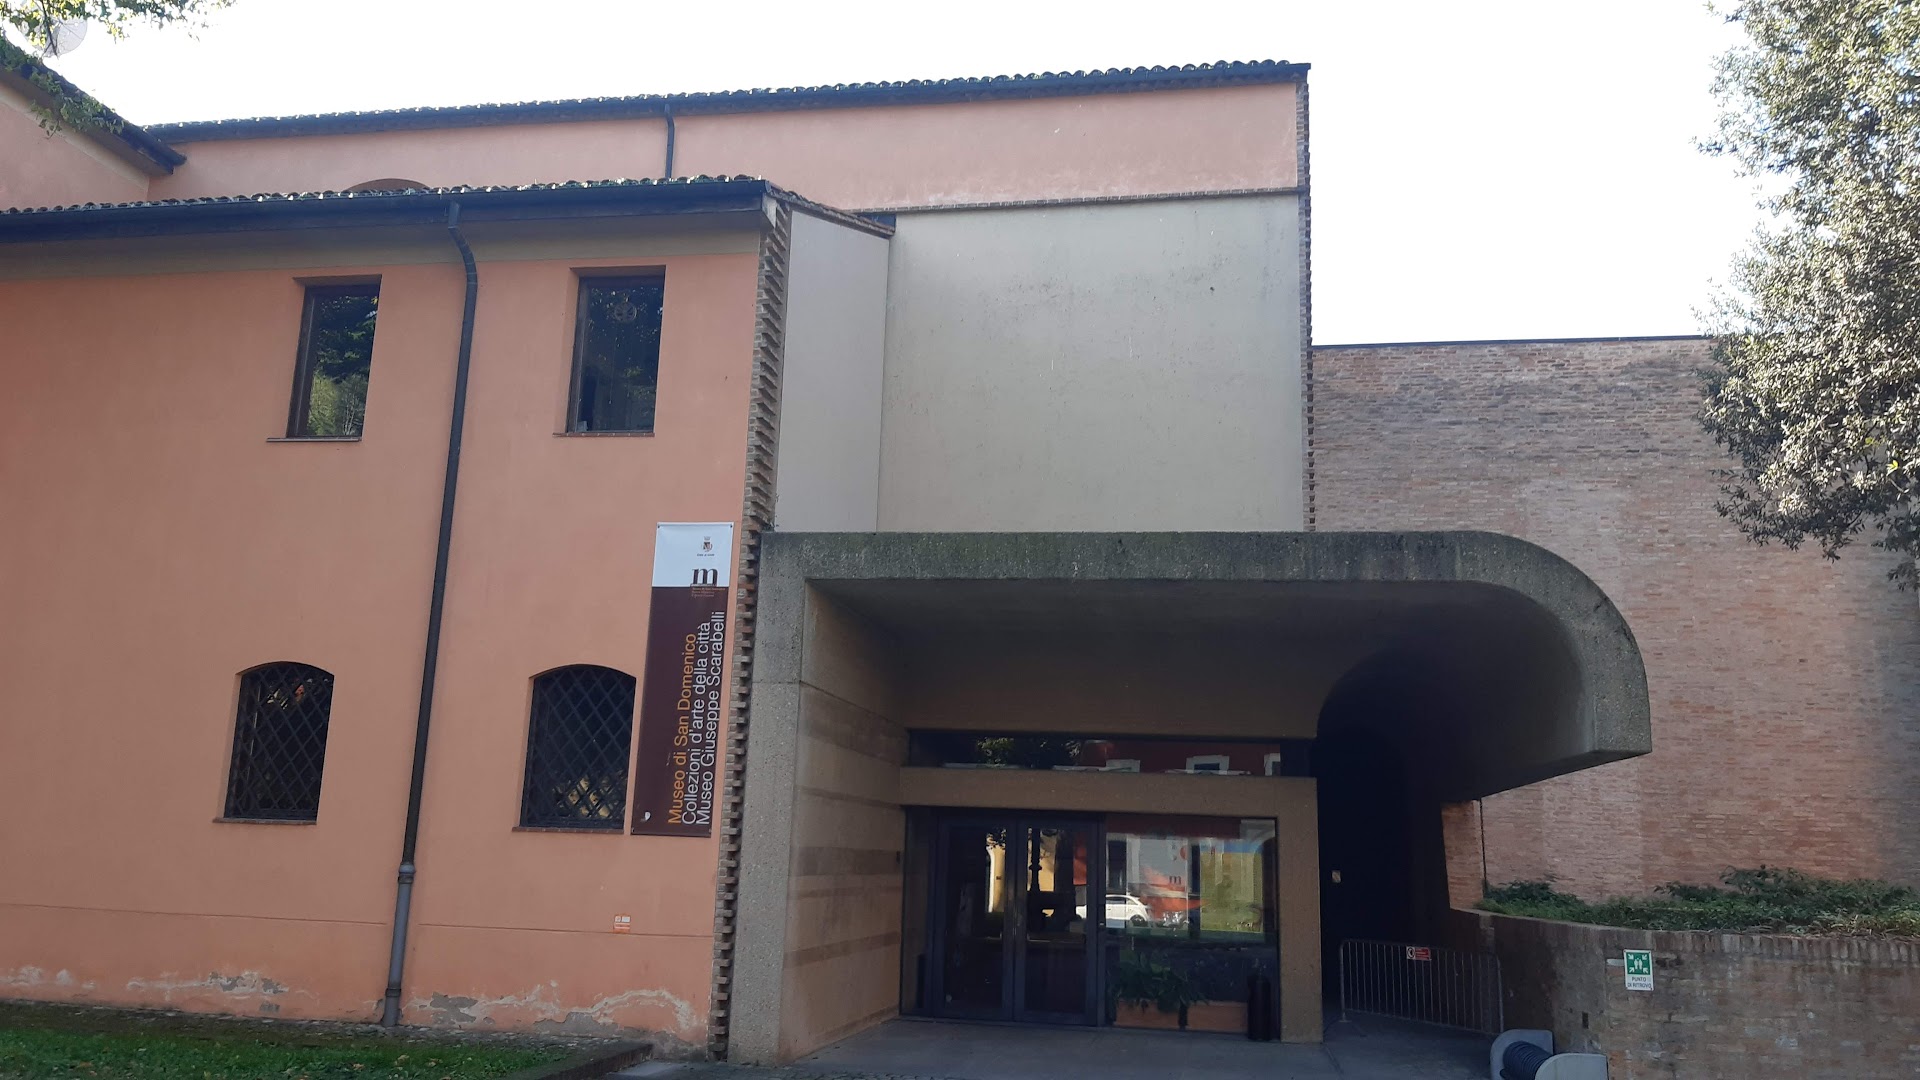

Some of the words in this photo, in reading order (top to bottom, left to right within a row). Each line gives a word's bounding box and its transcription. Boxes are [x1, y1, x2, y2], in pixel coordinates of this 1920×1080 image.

[692, 568, 718, 585] m
[695, 622, 711, 654] città
[706, 611, 725, 686] Scarabelli
[677, 634, 696, 710] Domenico
[692, 657, 708, 695] della
[674, 715, 690, 747] San
[688, 699, 705, 744] d'arte
[700, 690, 721, 767] Giuseppe
[673, 751, 687, 766] di
[667, 770, 686, 824] Museo
[681, 748, 701, 825] Collezioni
[696, 771, 714, 825] Museo
